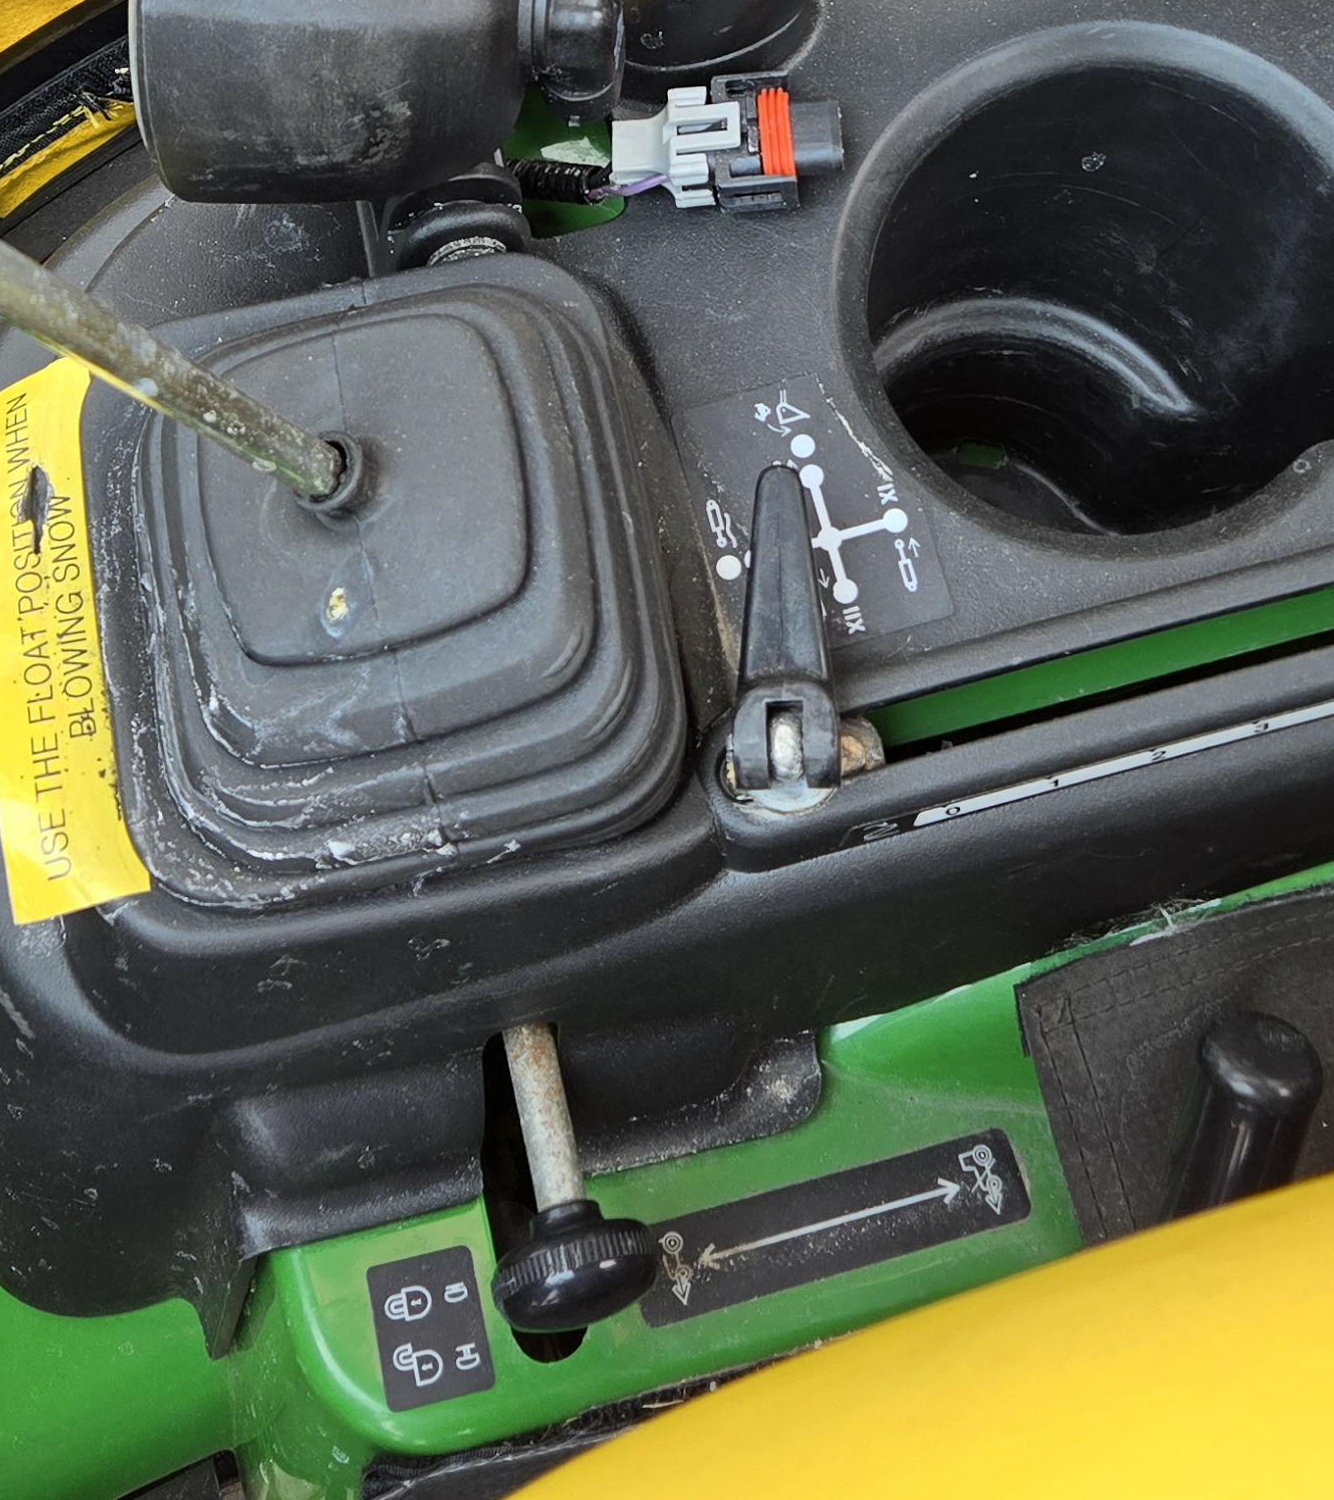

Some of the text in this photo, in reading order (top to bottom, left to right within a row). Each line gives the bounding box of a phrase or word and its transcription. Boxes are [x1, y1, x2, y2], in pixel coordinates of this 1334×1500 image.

[5, 392, 31, 474] WHEN
[47, 495, 97, 739] BLOWING SNOW
[19, 626, 56, 724] FLOAT
[30, 732, 62, 804] THE
[946, 806, 961, 816] 0
[1152, 750, 1166, 761] 2
[1254, 722, 1269, 733] 3
[38, 809, 72, 881] USE
